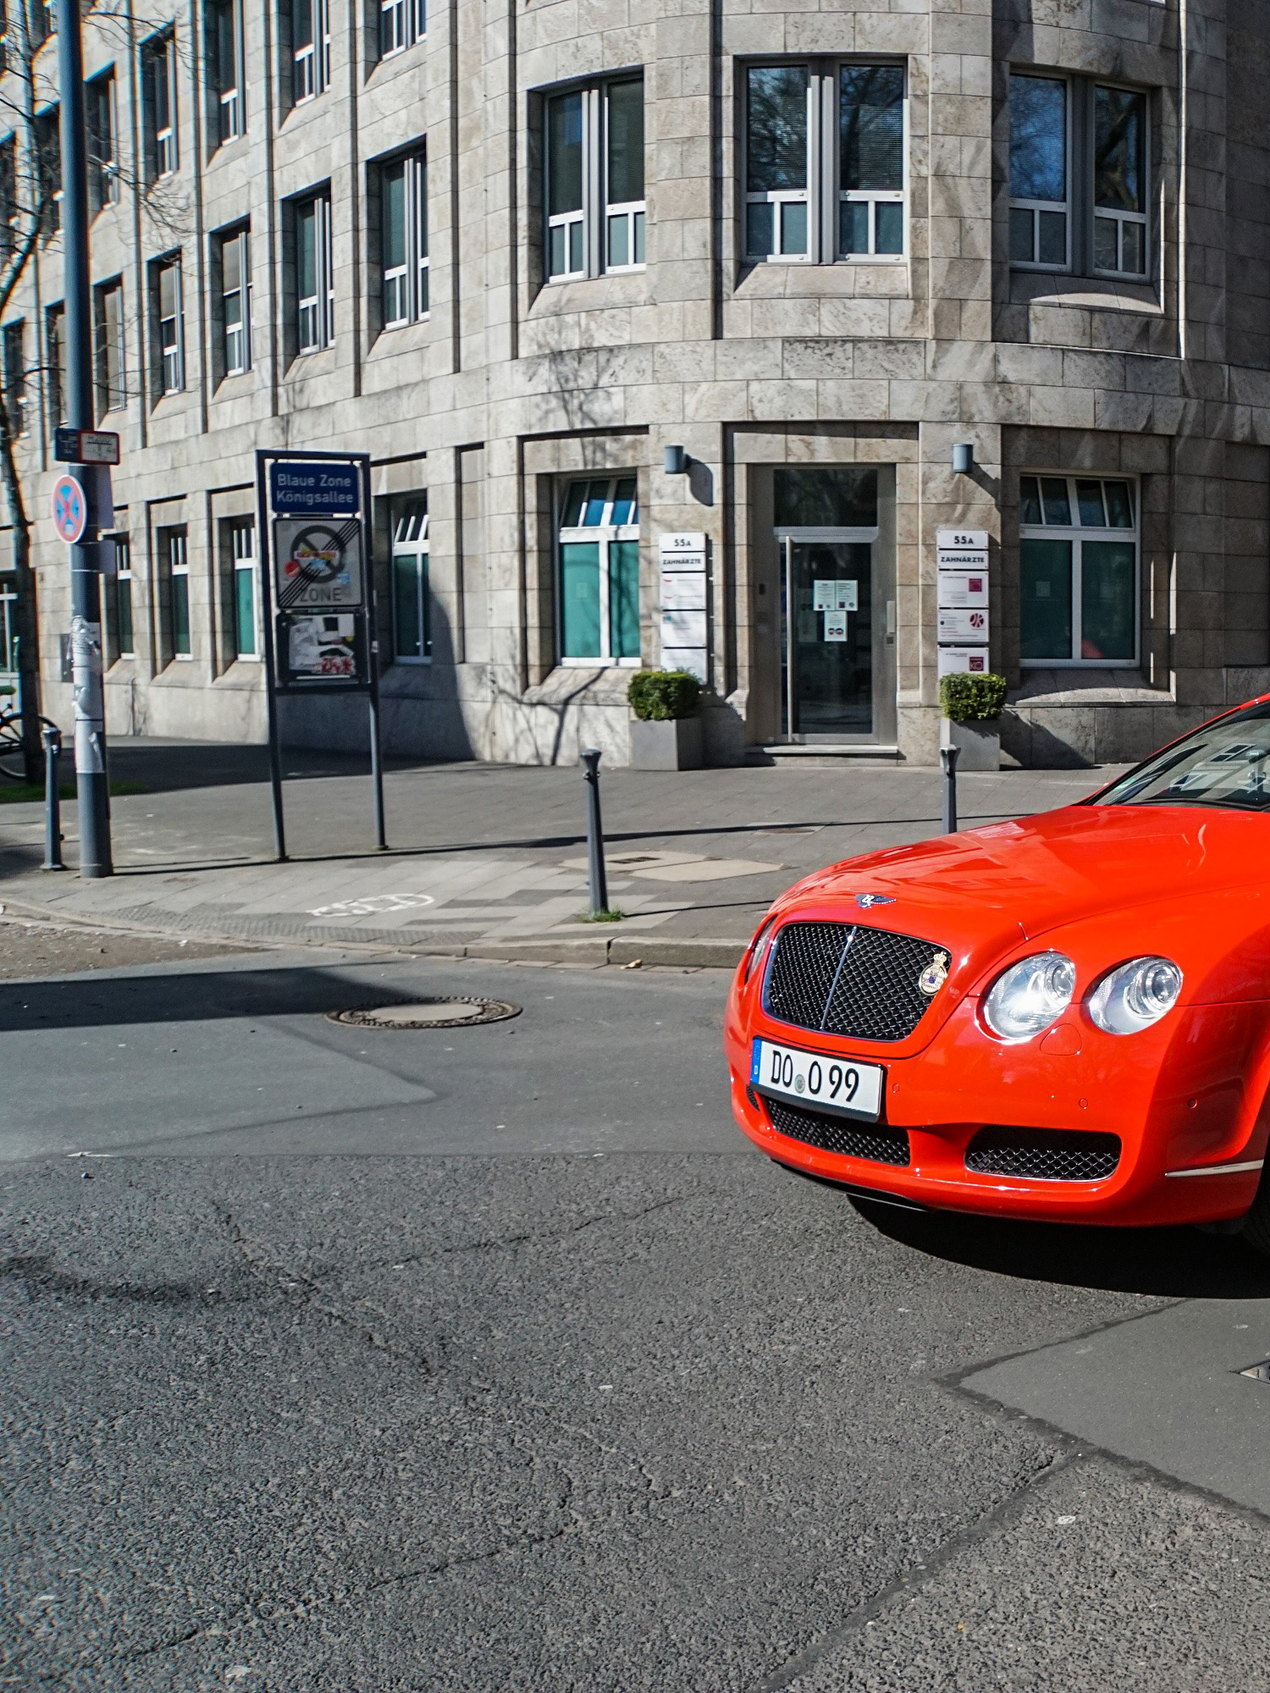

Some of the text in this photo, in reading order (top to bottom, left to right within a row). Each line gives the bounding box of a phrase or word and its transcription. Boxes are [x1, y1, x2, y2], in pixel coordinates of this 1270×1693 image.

[277, 474, 351, 487] Blaue Zone
[276, 490, 354, 506] Königsallee
[662, 557, 702, 565] ZAHNÄRZTE
[940, 555, 985, 563] ZAHNÄRZTE
[300, 587, 342, 602] ZONE
[771, 1049, 794, 1088] DO
[828, 1064, 860, 1103] 99
